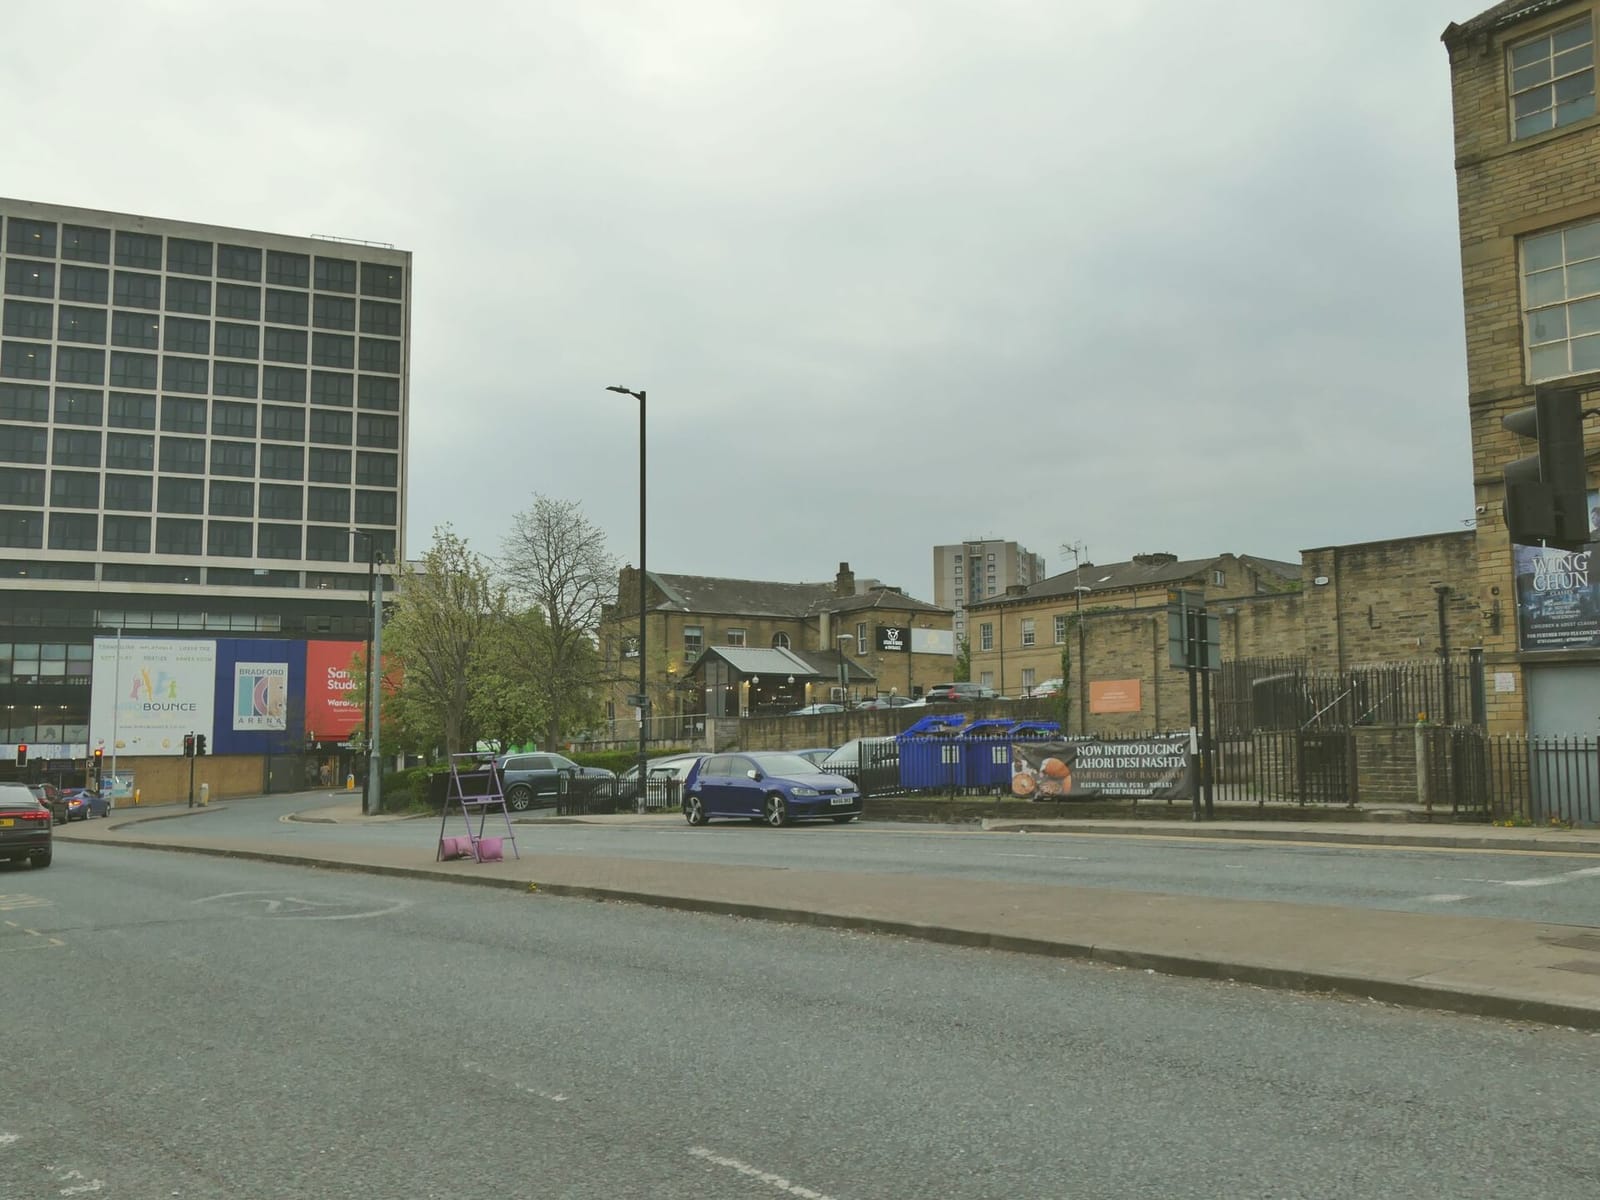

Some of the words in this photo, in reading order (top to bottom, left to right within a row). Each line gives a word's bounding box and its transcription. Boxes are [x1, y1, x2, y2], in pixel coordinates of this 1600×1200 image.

[1532, 554, 1589, 574] WING
[1533, 571, 1589, 591] CHUN
[239, 668, 284, 676] BRADFORD
[143, 703, 197, 711] BOUNCE
[1076, 745, 1102, 757] NOW
[1104, 743, 1184, 756] INTRODUCING
[1075, 758, 1114, 769] LAHORI
[1116, 757, 1139, 768] DESI
[1141, 756, 1187, 768] NASHTA
